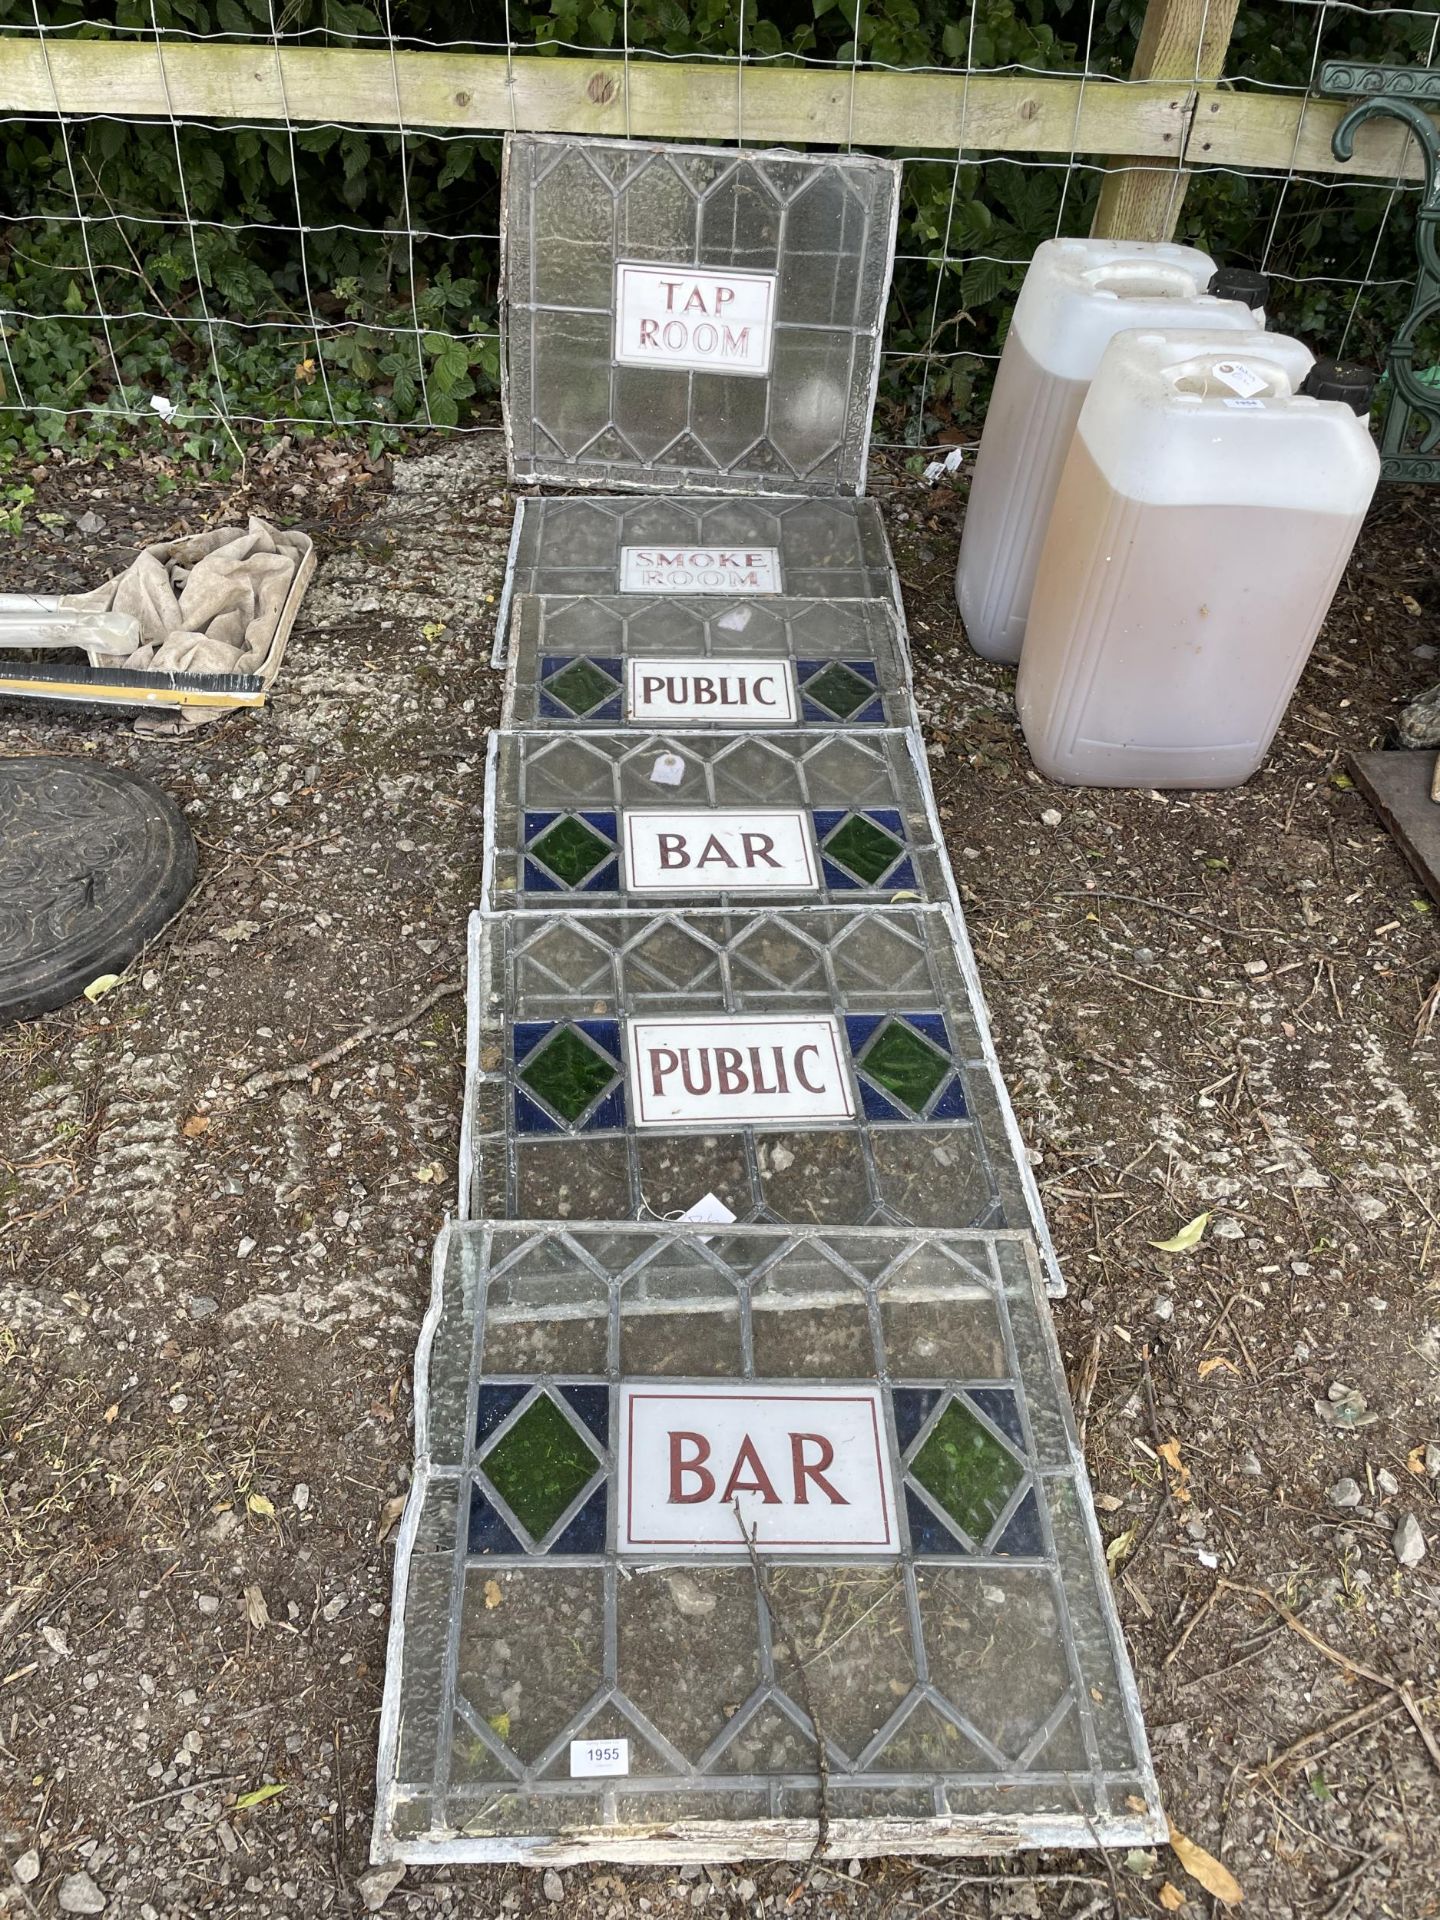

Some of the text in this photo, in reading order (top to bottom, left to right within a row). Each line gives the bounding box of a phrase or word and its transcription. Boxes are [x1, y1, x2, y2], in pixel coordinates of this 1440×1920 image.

[659, 280, 735, 317] TAP
[638, 318, 751, 358] ROOM
[636, 552, 767, 567] SMOKE
[642, 570, 760, 587] ROOM
[642, 676, 776, 705] PUBLIC
[656, 832, 785, 869] BAR
[647, 1044, 826, 1097] PUBLIC
[666, 1431, 851, 1505] BAR
[587, 1748, 619, 1761] 1955
